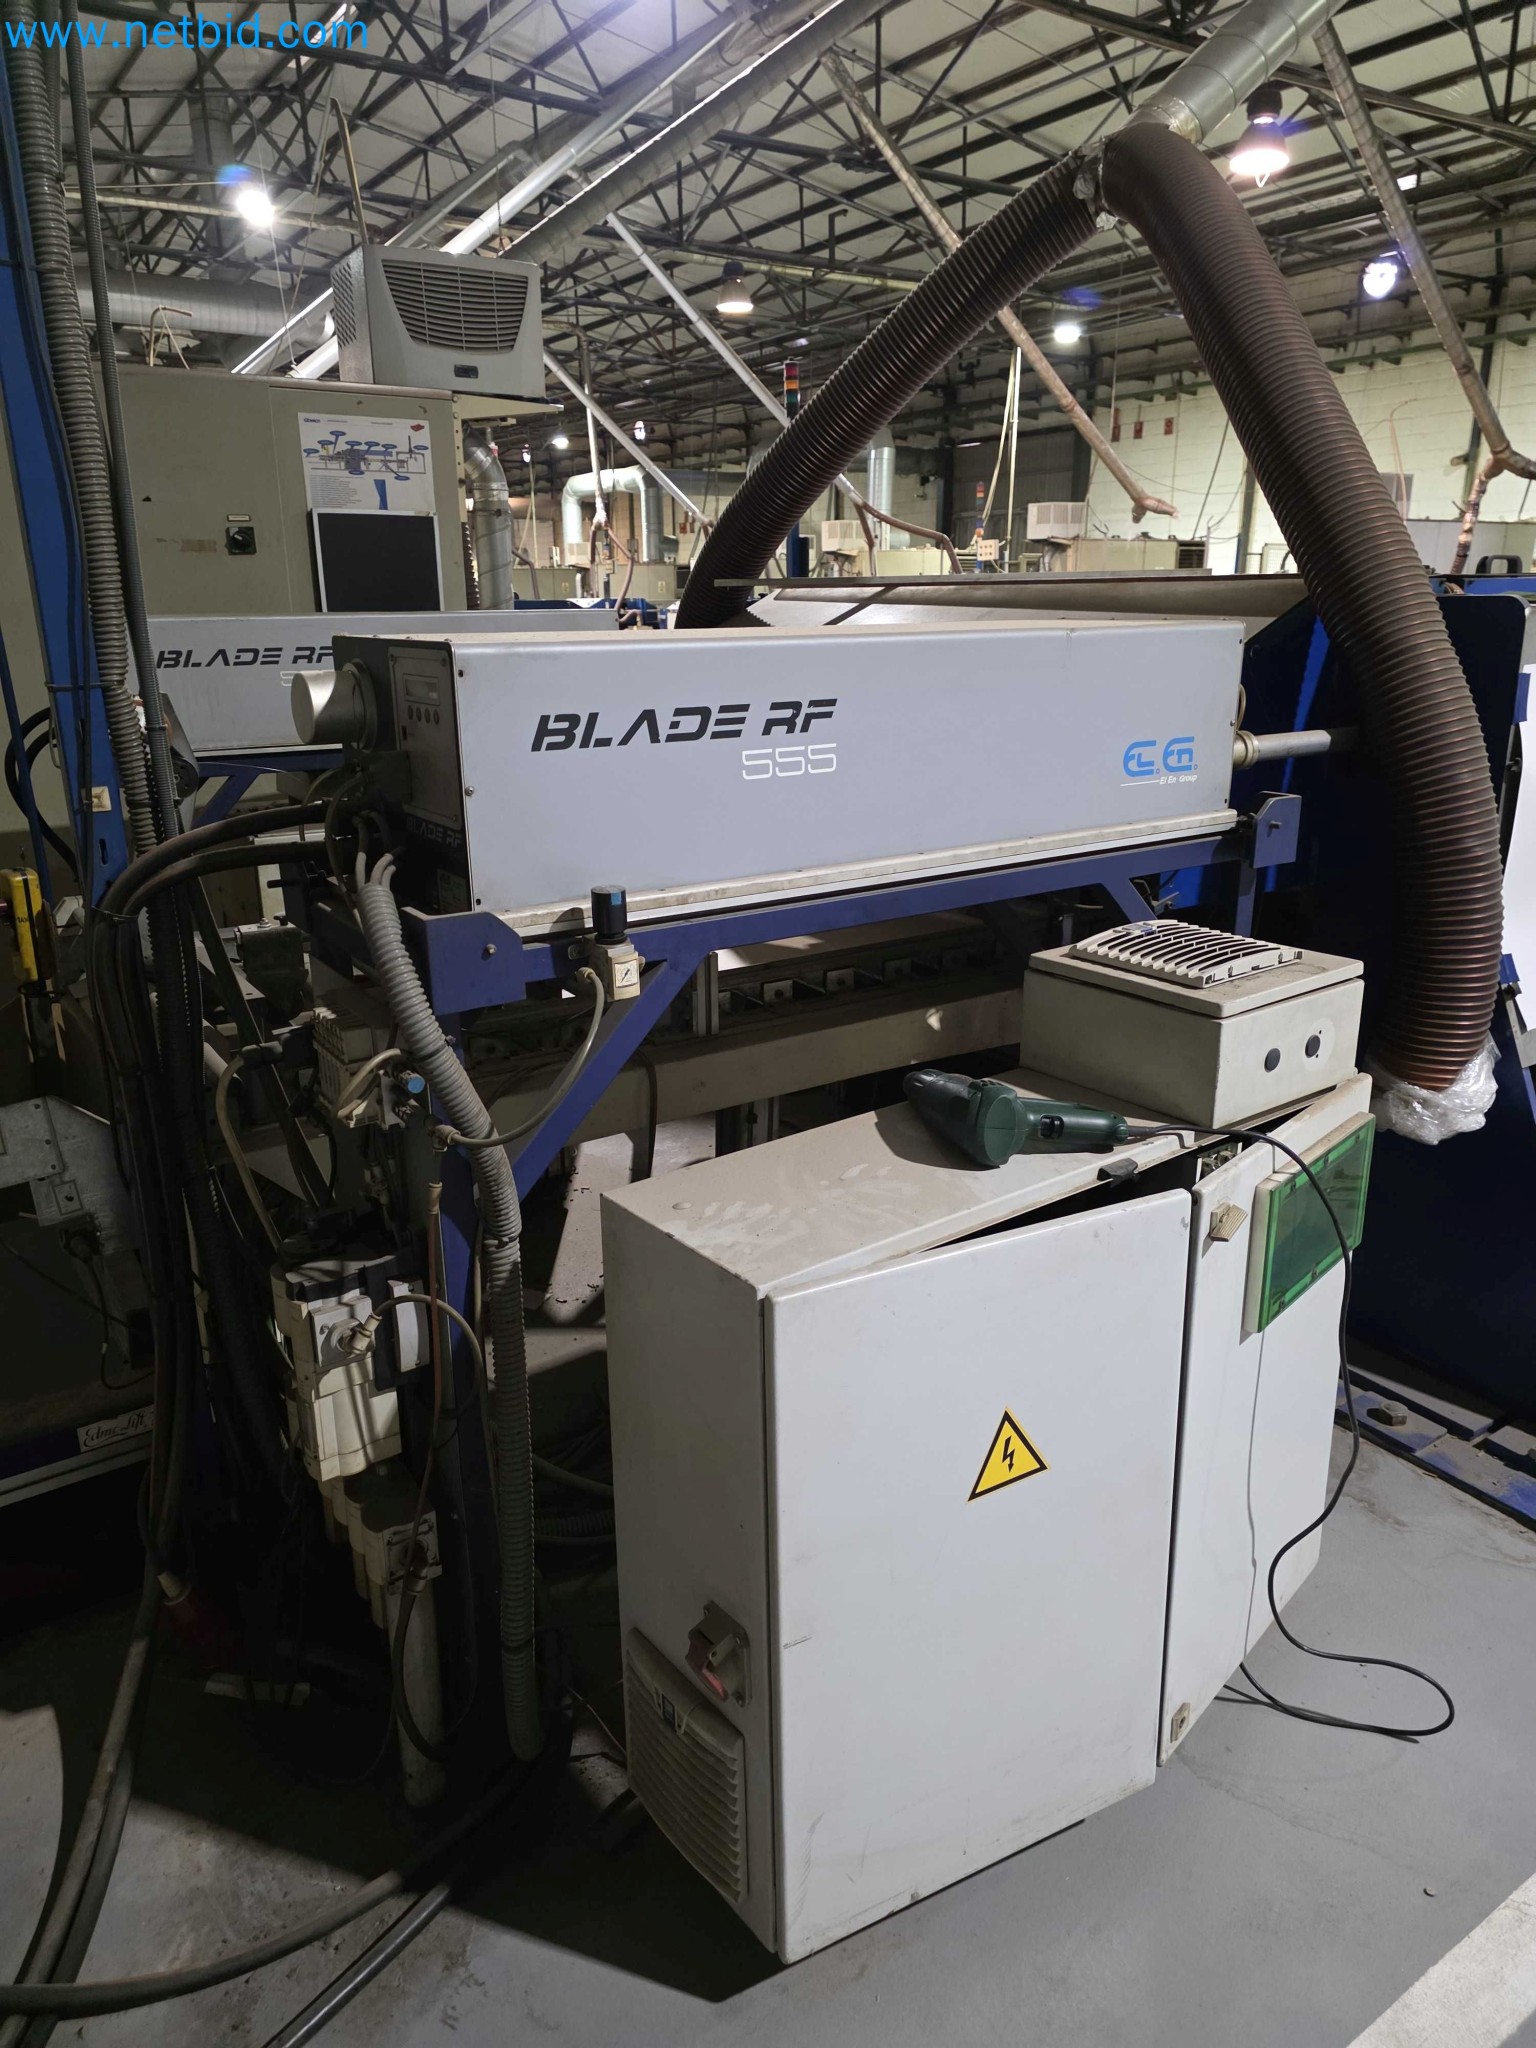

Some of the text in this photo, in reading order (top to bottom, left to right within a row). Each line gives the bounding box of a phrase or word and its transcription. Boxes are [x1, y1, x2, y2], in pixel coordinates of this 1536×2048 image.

[157, 646, 333, 669] BLADE RF
[530, 698, 838, 752] BLADE RF
[741, 743, 837, 780] 555
[1168, 775, 1176, 784] En
[1179, 774, 1198, 783] Group
[406, 816, 464, 848] BLADE RF
